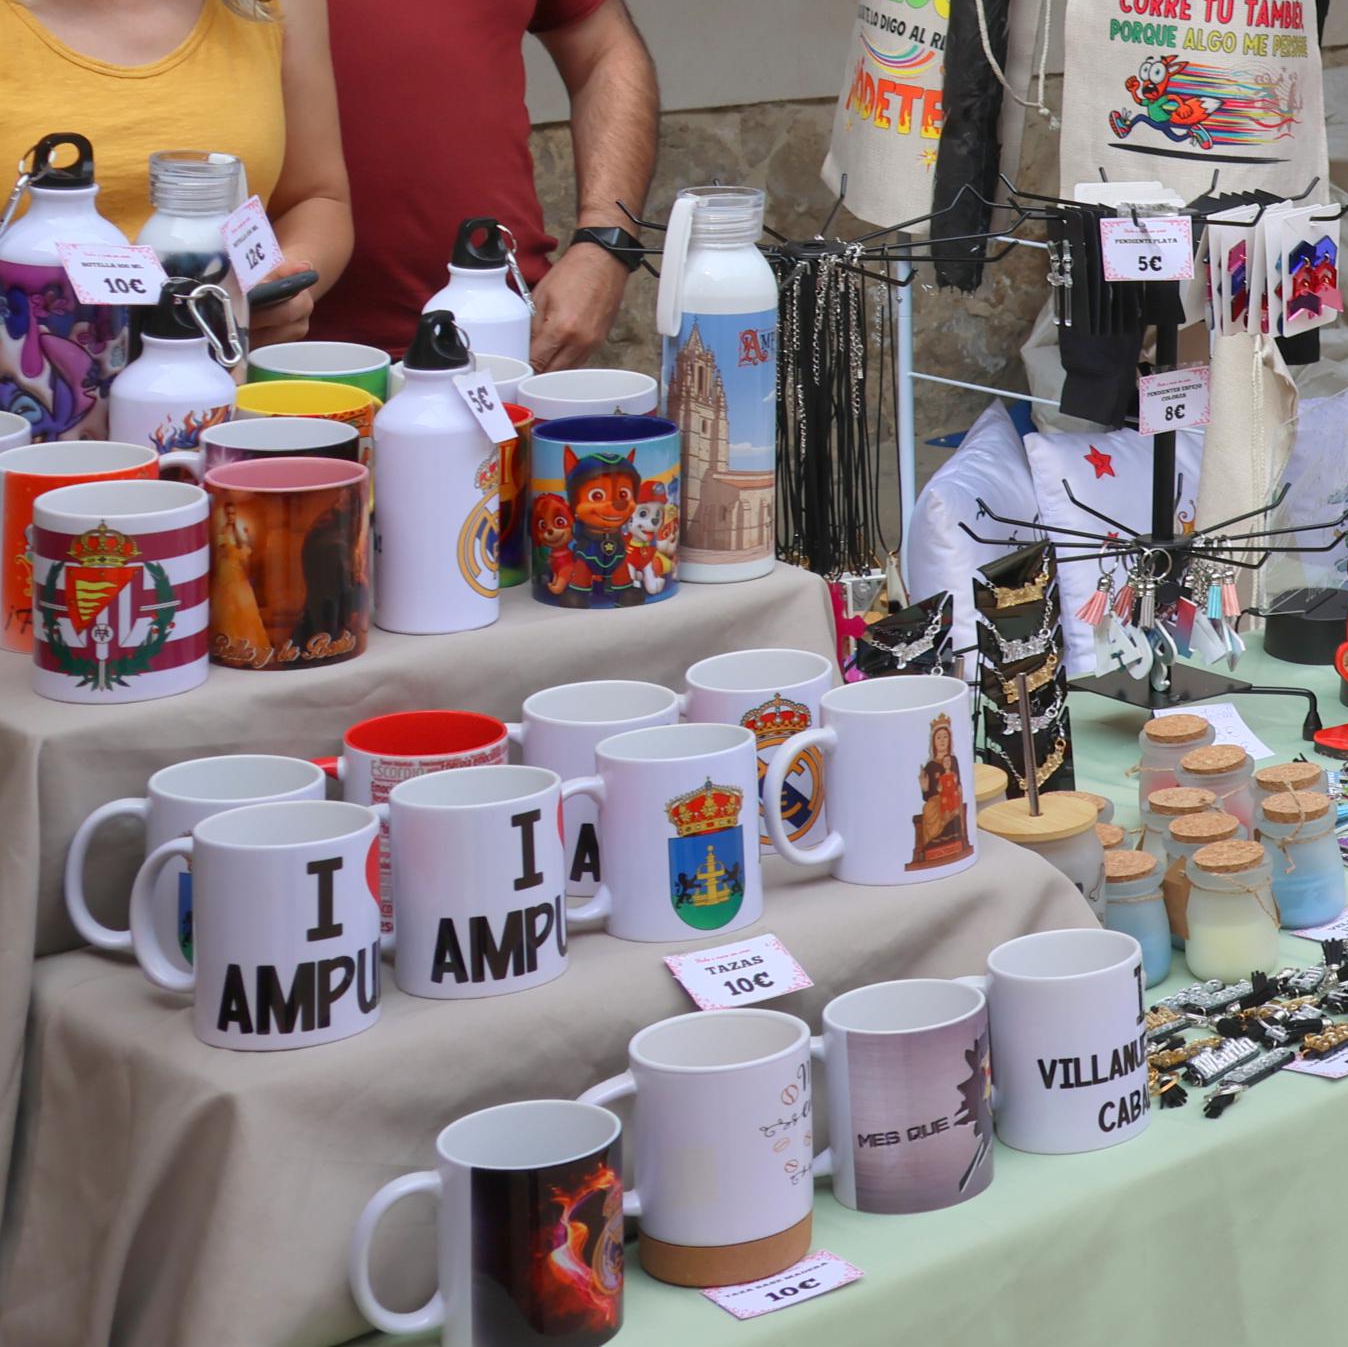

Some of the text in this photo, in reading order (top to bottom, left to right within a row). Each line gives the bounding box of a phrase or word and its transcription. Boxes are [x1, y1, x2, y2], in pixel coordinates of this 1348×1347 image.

[880, 14, 926, 44] DIGO AL
[1110, 19, 1268, 57] PORQUE ALGO ME
[245, 243, 266, 270] 12€
[1138, 256, 1162, 272] 5€
[104, 277, 147, 295] 10€
[467, 386, 494, 413] 5€
[1165, 404, 1185, 421] 8€
[511, 808, 544, 891] I
[306, 856, 343, 942] I
[705, 955, 764, 976] TAZAS
[723, 971, 775, 996] 10€
[858, 1116, 950, 1148] MES QUE
[764, 1277, 821, 1303] 10€
